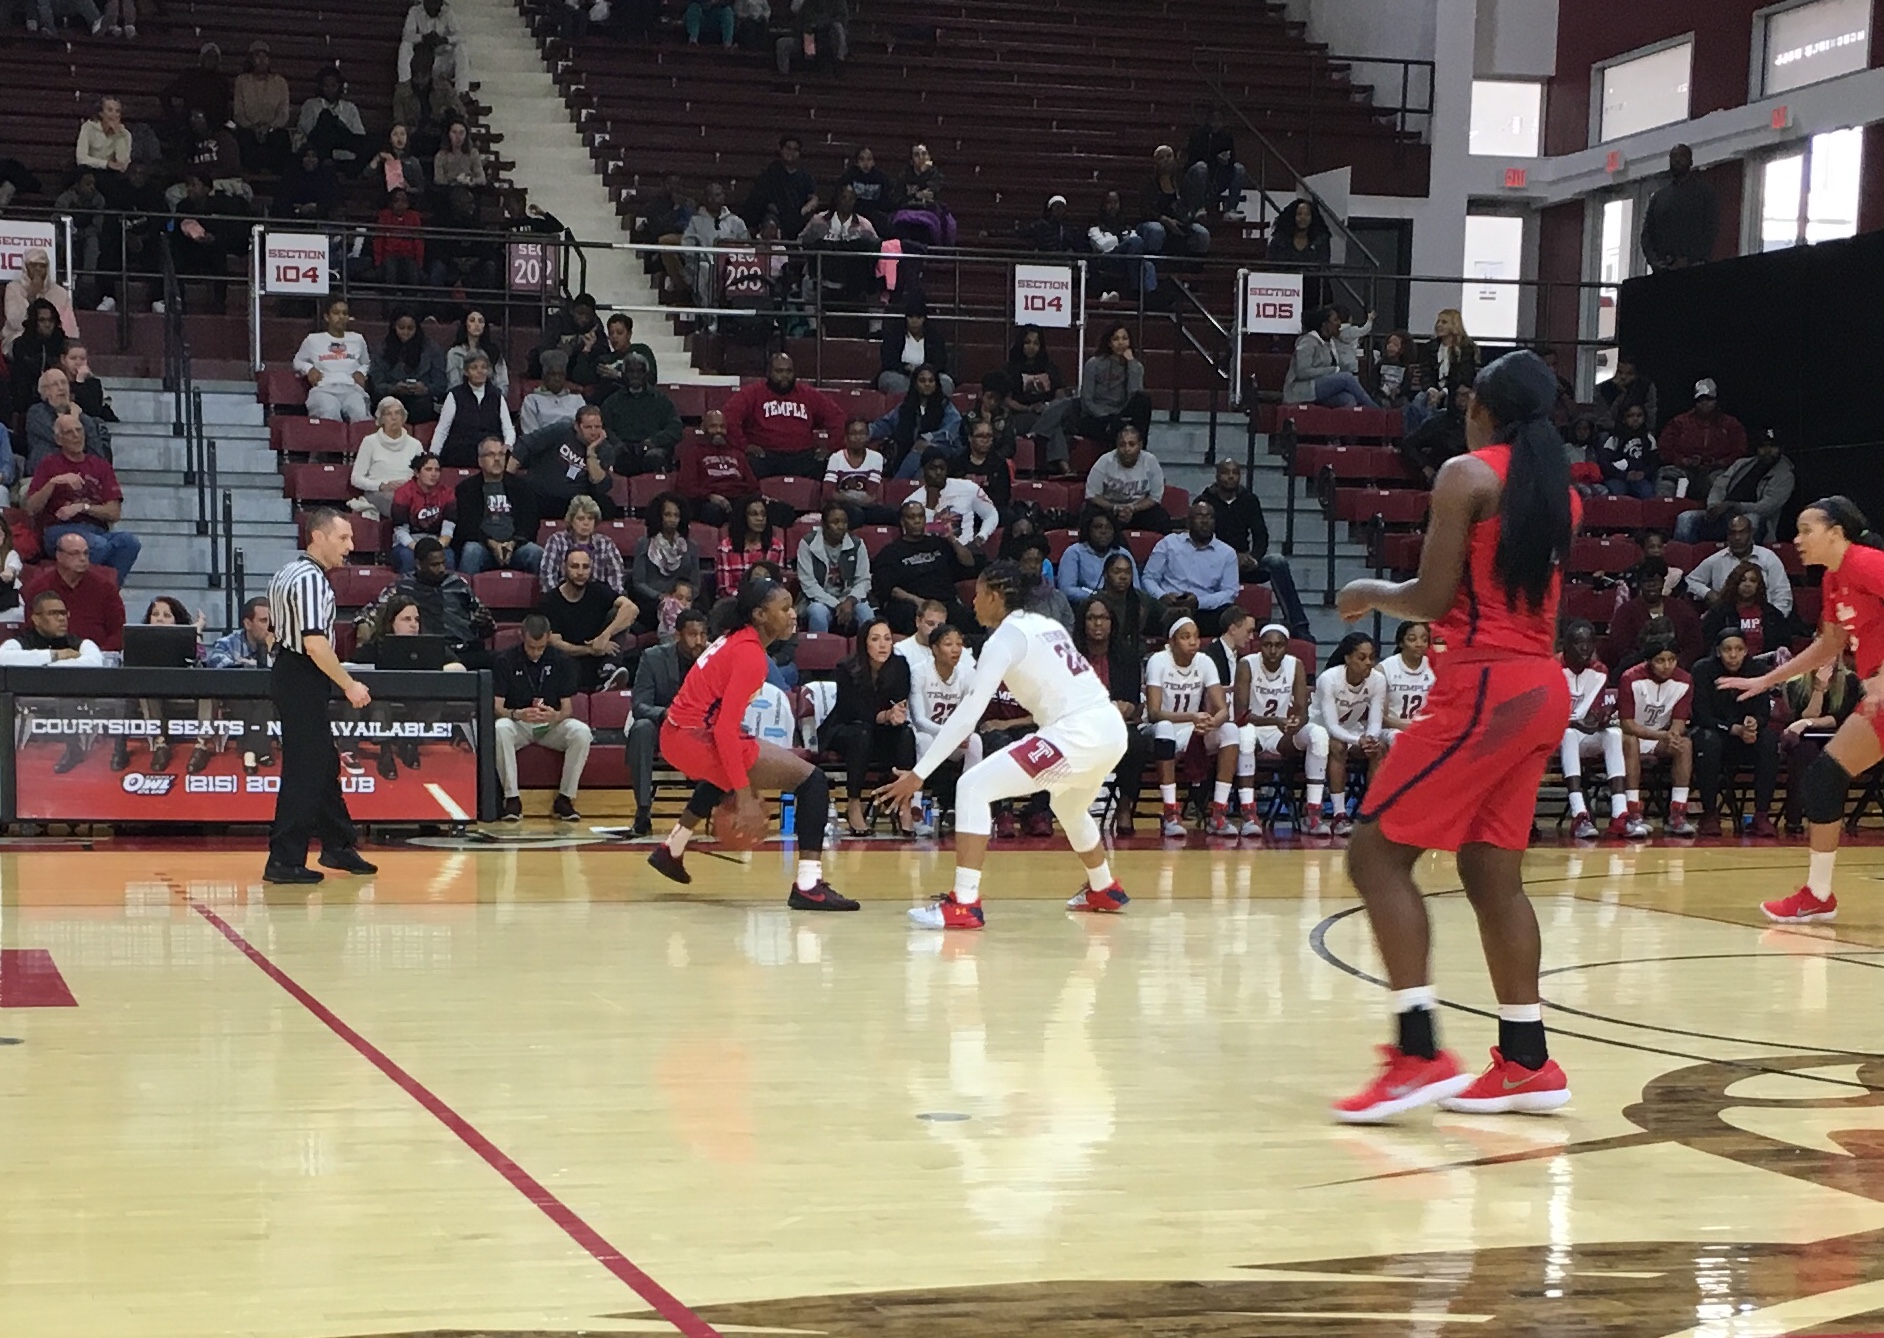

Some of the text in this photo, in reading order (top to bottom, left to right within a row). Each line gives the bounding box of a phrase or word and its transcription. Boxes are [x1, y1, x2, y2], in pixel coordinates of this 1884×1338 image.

[0, 236, 52, 247] ECTION
[1, 252, 24, 270] 10
[268, 248, 325, 260] SECTION
[275, 265, 320, 283] 104
[1017, 279, 1069, 290] SECTION
[1249, 287, 1300, 297] SECTION
[1023, 294, 1063, 312] 104
[1255, 302, 1294, 319] 105
[762, 400, 808, 420] TEMPLE
[1164, 681, 1201, 691] TEMPLE
[1256, 685, 1290, 697] TEMPLE
[926, 691, 962, 701] TEMPL
[1173, 693, 1191, 713] 11
[1263, 698, 1278, 717] 2
[1400, 694, 1423, 720] 12
[31, 718, 162, 736] COURTSIDE
[168, 719, 245, 736] SEATS
[1027, 739, 1055, 764] T
[184, 774, 238, 793] (215)
[245, 776, 282, 793] 20
